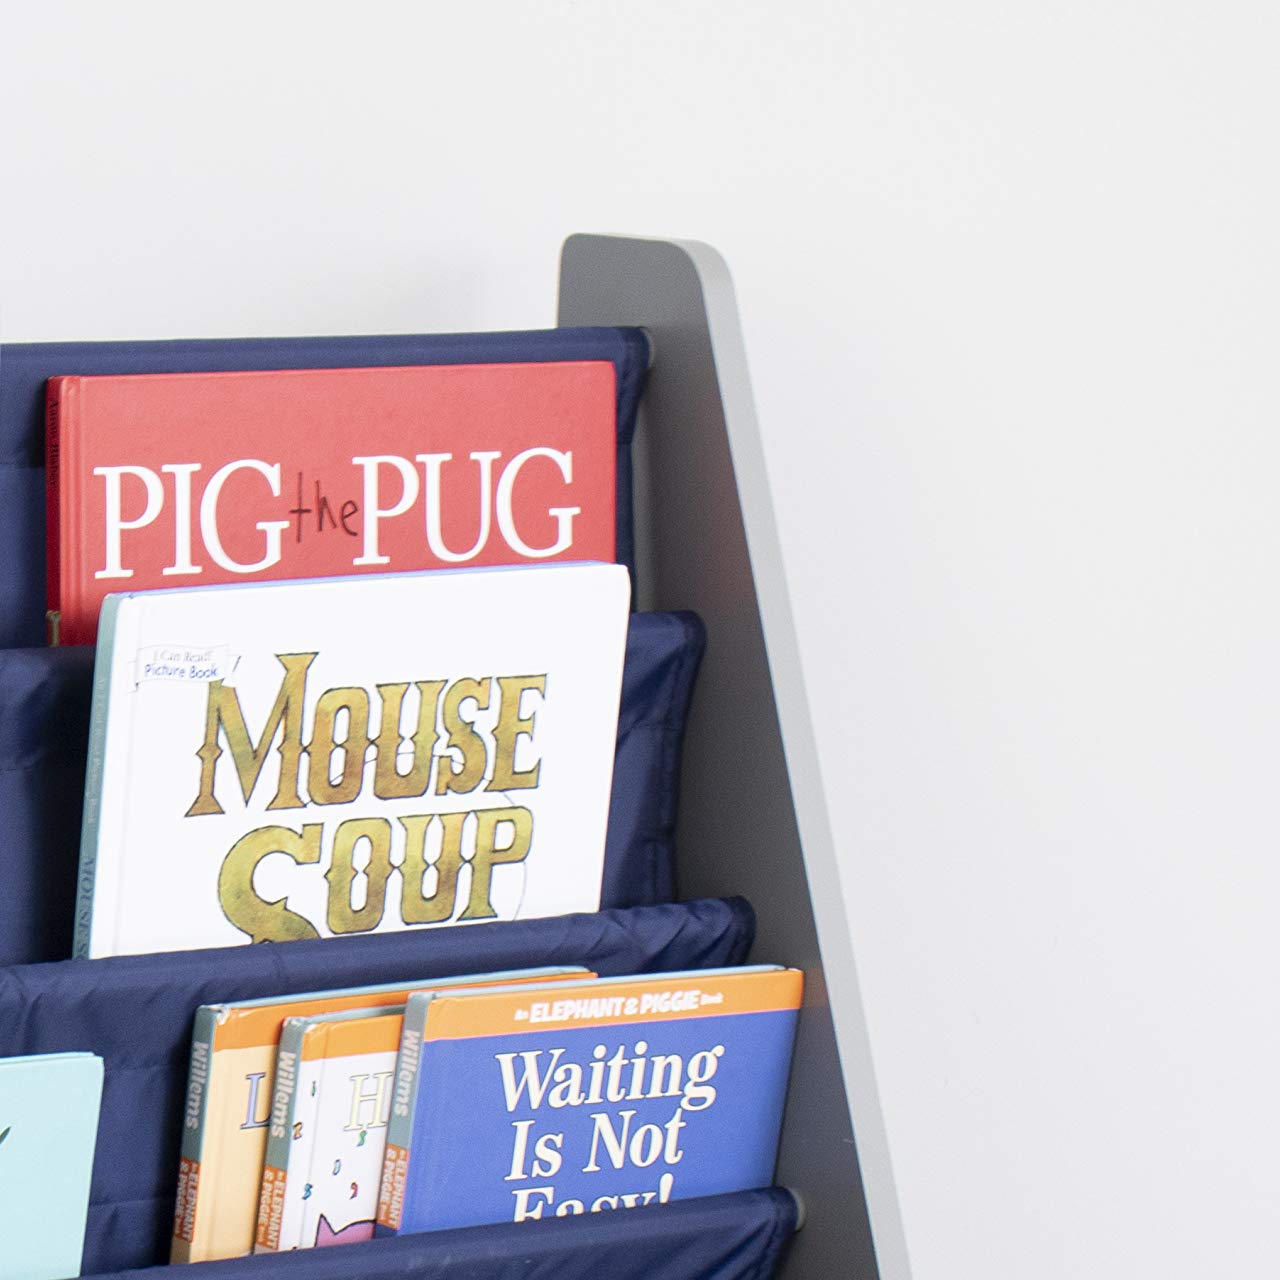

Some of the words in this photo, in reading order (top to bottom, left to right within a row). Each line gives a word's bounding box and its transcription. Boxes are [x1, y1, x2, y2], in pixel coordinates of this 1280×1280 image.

[94, 458, 290, 580] PIG
[289, 470, 359, 544] the
[352, 446, 581, 566] PUG
[144, 663, 186, 678] Picture
[189, 663, 218, 679] Book
[184, 651, 549, 818] MOUSE
[217, 804, 534, 944] SOUP
[529, 997, 625, 1023] ELEPHANT
[623, 996, 638, 1016] &
[639, 989, 701, 1015] PIGGIE
[185, 1041, 210, 1131] Willems
[271, 1051, 297, 1139] Willems
[393, 1029, 421, 1118] Willems
[495, 1041, 725, 1112] Waiting
[504, 1120, 564, 1181] Is
[581, 1108, 687, 1173] Not
